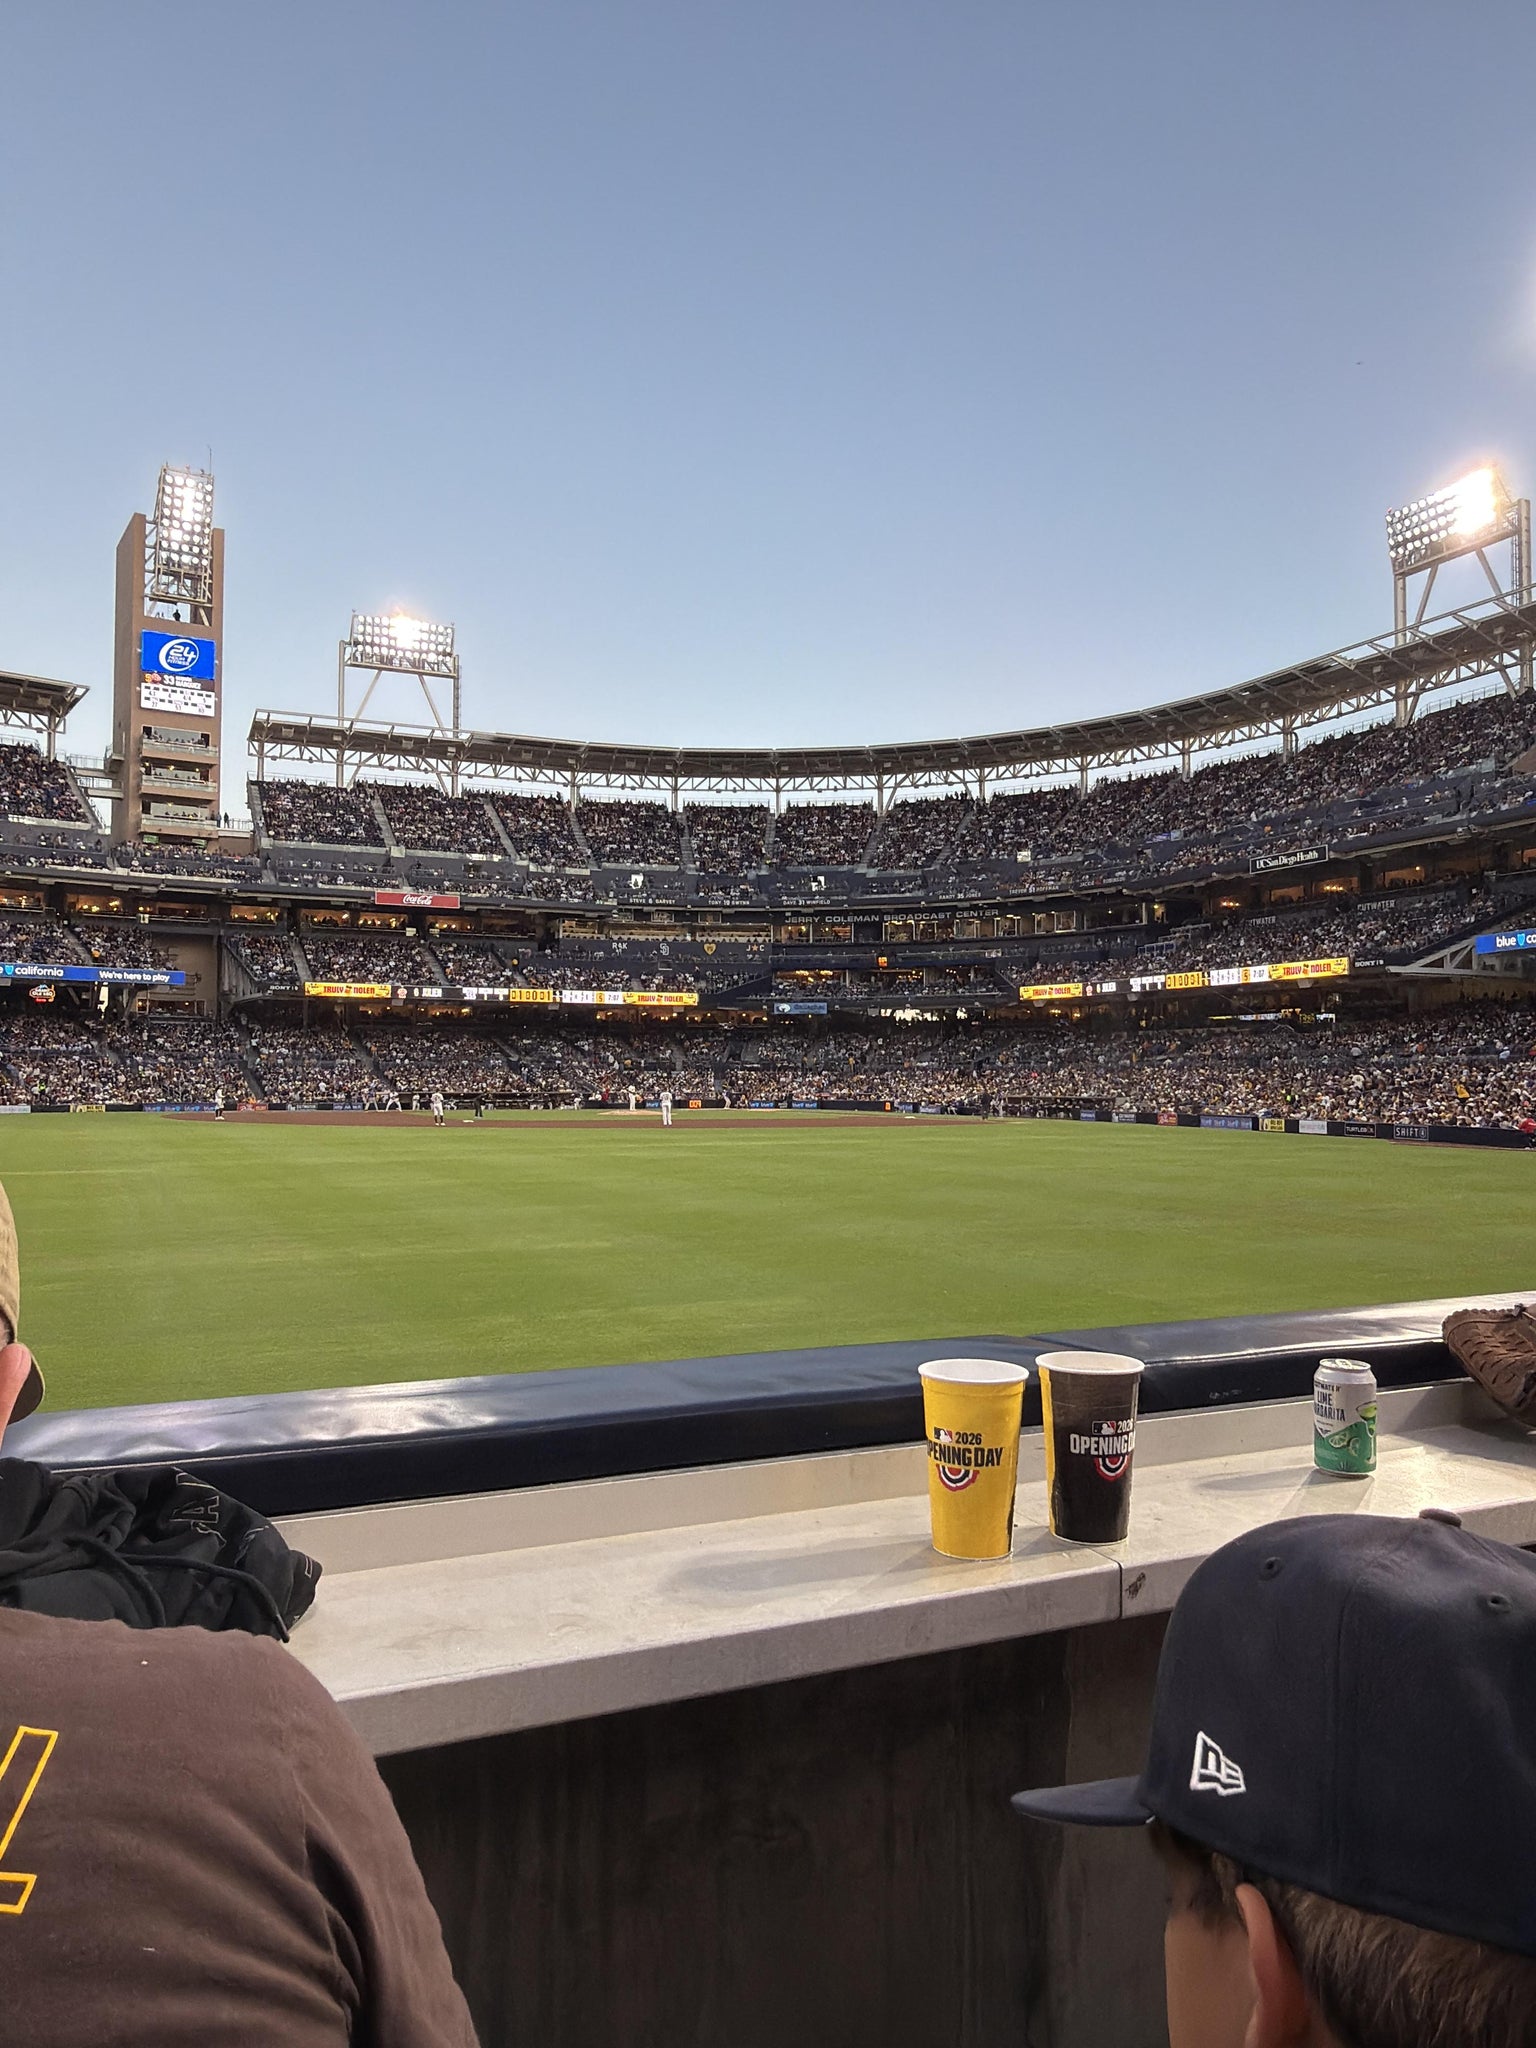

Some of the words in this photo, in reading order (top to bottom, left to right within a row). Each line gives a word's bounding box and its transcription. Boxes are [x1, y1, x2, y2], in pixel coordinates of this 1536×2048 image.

[169, 645, 196, 662] 24
[1256, 860, 1268, 869] UC
[1268, 857, 1279, 867] San
[1278, 854, 1297, 866] Diego
[1296, 850, 1319, 862] Health
[785, 915, 820, 923] JERRY
[825, 914, 879, 923] COLEMAN
[884, 911, 952, 921] BROADCAST
[955, 909, 999, 918] CENTER
[1496, 935, 1517, 948] blue
[1283, 965, 1302, 976] TRULY
[1310, 962, 1332, 974] NOLEN
[1354, 960, 1377, 968] SONY
[15, 966, 64, 977] california
[99, 970, 122, 980] We're
[123, 972, 142, 981] here
[142, 973, 151, 981] to
[152, 973, 171, 983] play
[323, 985, 344, 993] TRULY
[353, 986, 375, 994] NOLEN
[1396, 1127, 1419, 1138] SHIFT
[1317, 1390, 1333, 1406] LIME
[955, 1431, 982, 1445] 2026
[1070, 1433, 1129, 1456] OPENING
[974, 1447, 1003, 1468] DAY
